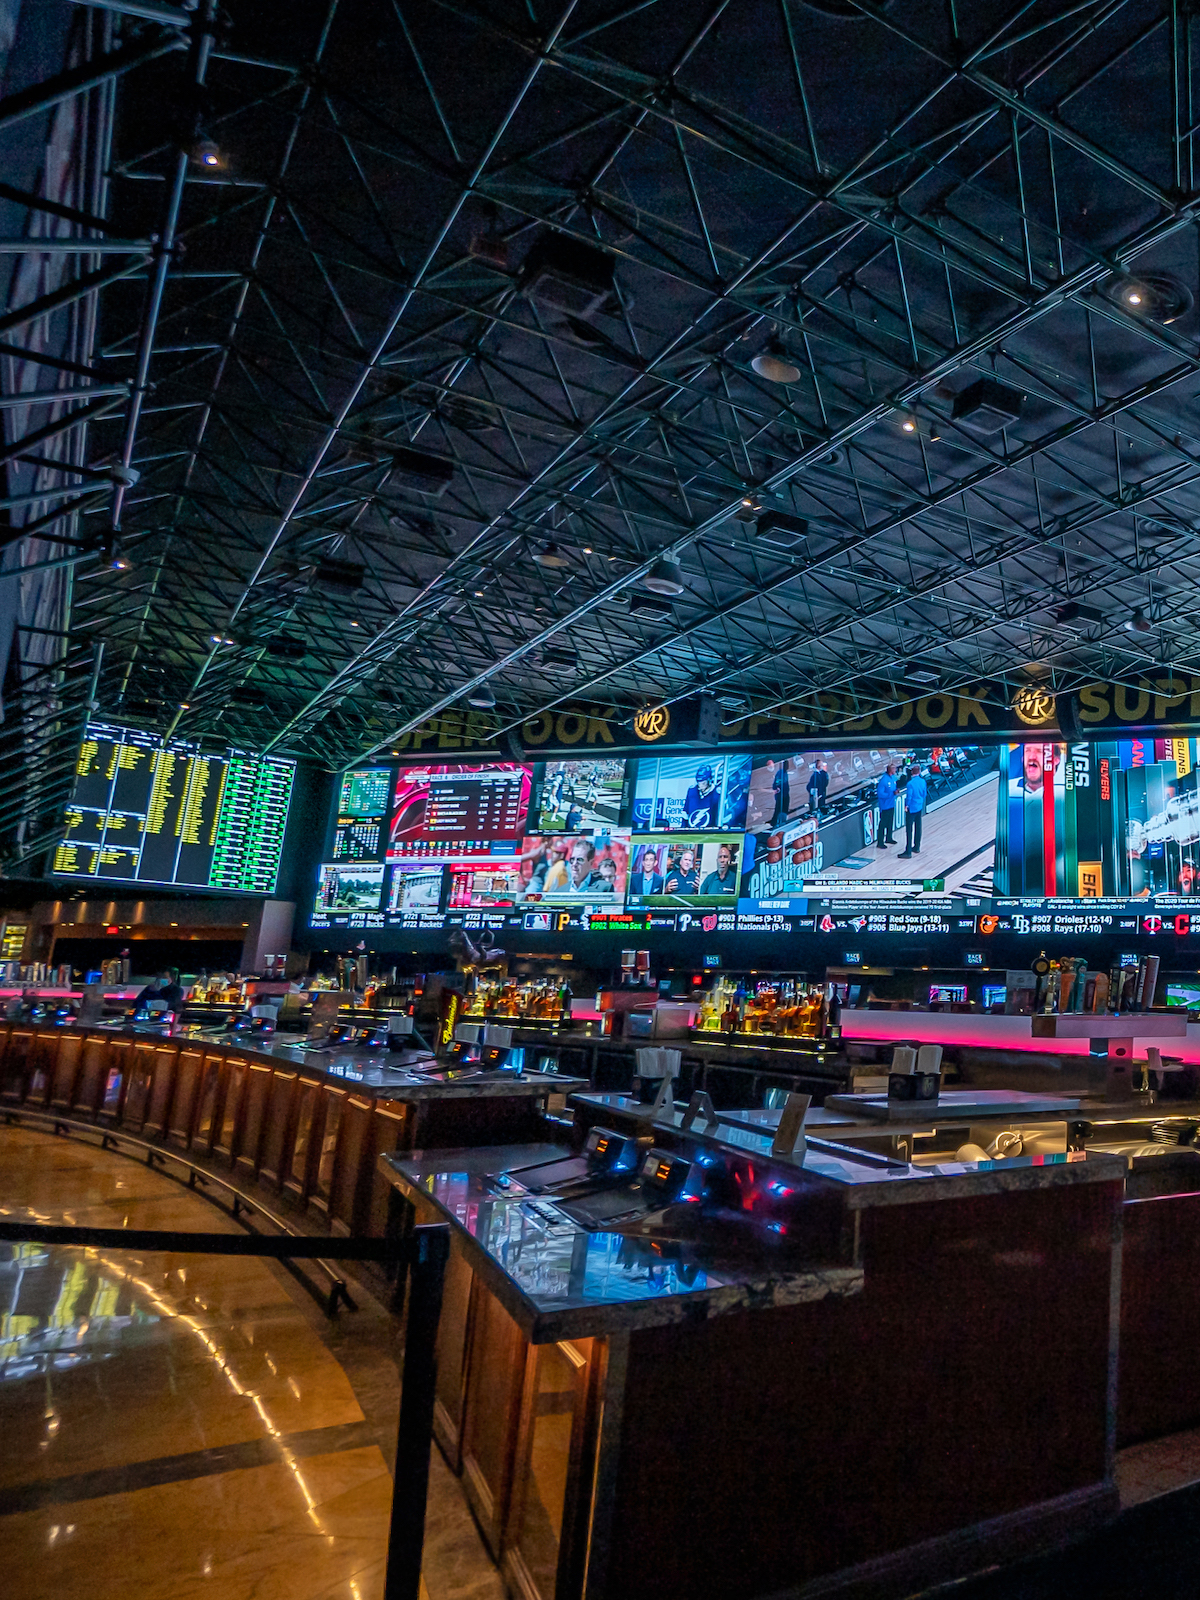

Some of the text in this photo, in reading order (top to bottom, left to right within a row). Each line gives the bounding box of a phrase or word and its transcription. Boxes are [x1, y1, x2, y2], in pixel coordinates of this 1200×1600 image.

[1177, 741, 1186, 774] GUINS
[1065, 763, 1074, 790] WILD
[1100, 759, 1110, 800] FLYERS
[367, 913, 385, 921] Magic
[718, 914, 784, 923] #903 Phillies (9-13)
[868, 915, 941, 924] #905 Red Sox (9-18)
[1055, 915, 1084, 924] Orioles
[1085, 915, 1112, 924] (12-14)
[609, 922, 628, 930] White
[629, 922, 642, 930] Sox
[737, 923, 771, 931] Nationals
[771, 923, 792, 932] (9-13)
[867, 924, 887, 932] #906
[889, 924, 905, 932] Blue
[906, 924, 923, 934] Jays
[924, 924, 949, 933] (13-11)
[1055, 925, 1073, 934] Rays
[1075, 925, 1102, 934] (17-10)
